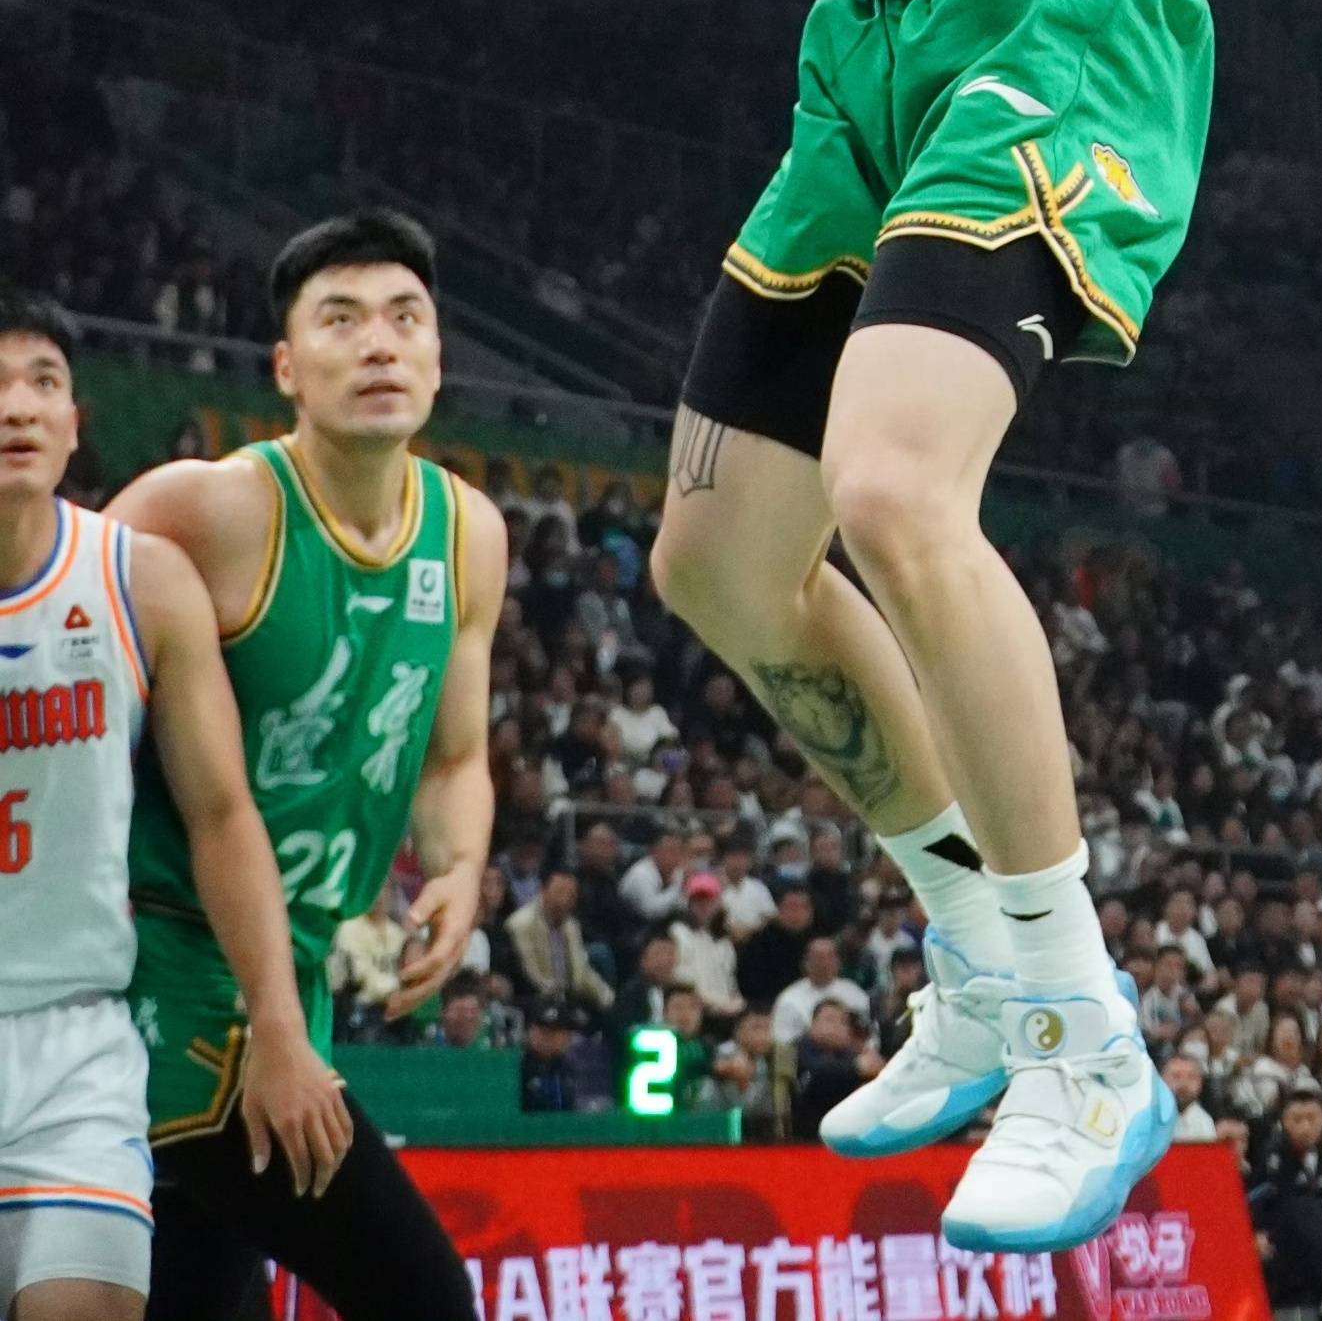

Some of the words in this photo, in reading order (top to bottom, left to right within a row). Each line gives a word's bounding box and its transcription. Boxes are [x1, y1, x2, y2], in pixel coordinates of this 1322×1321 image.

[0, 678, 107, 754] UAN
[629, 1029, 678, 1115] 2
[465, 1233, 1057, 1321] A联赛官方能量饮料
